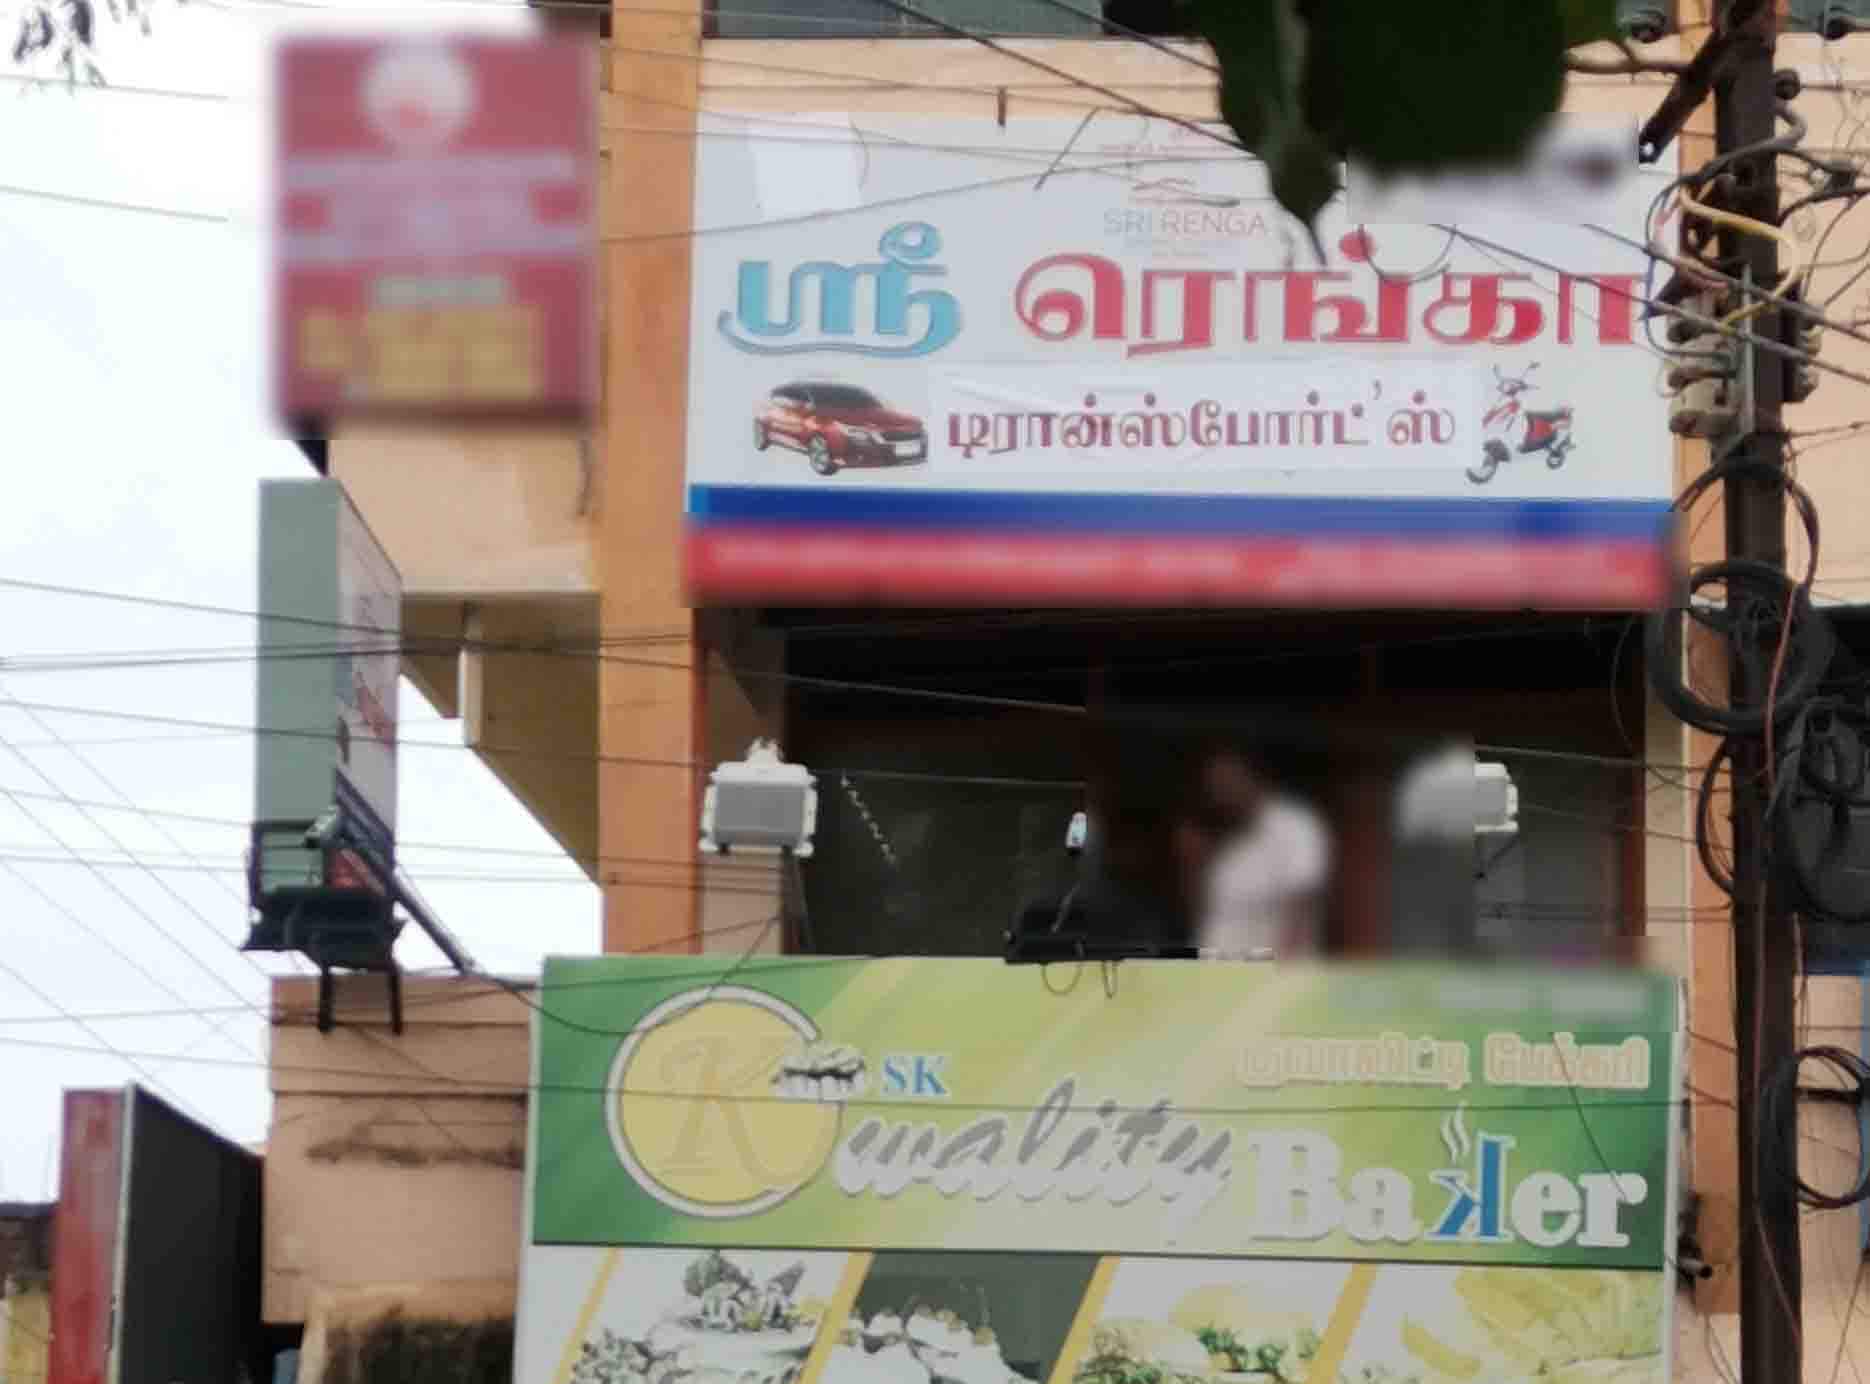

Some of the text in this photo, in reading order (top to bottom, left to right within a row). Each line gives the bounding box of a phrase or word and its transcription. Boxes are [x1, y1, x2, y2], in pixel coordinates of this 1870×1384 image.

[1103, 208, 1266, 234] SRI RENGA
[882, 1054, 947, 1096] SK
